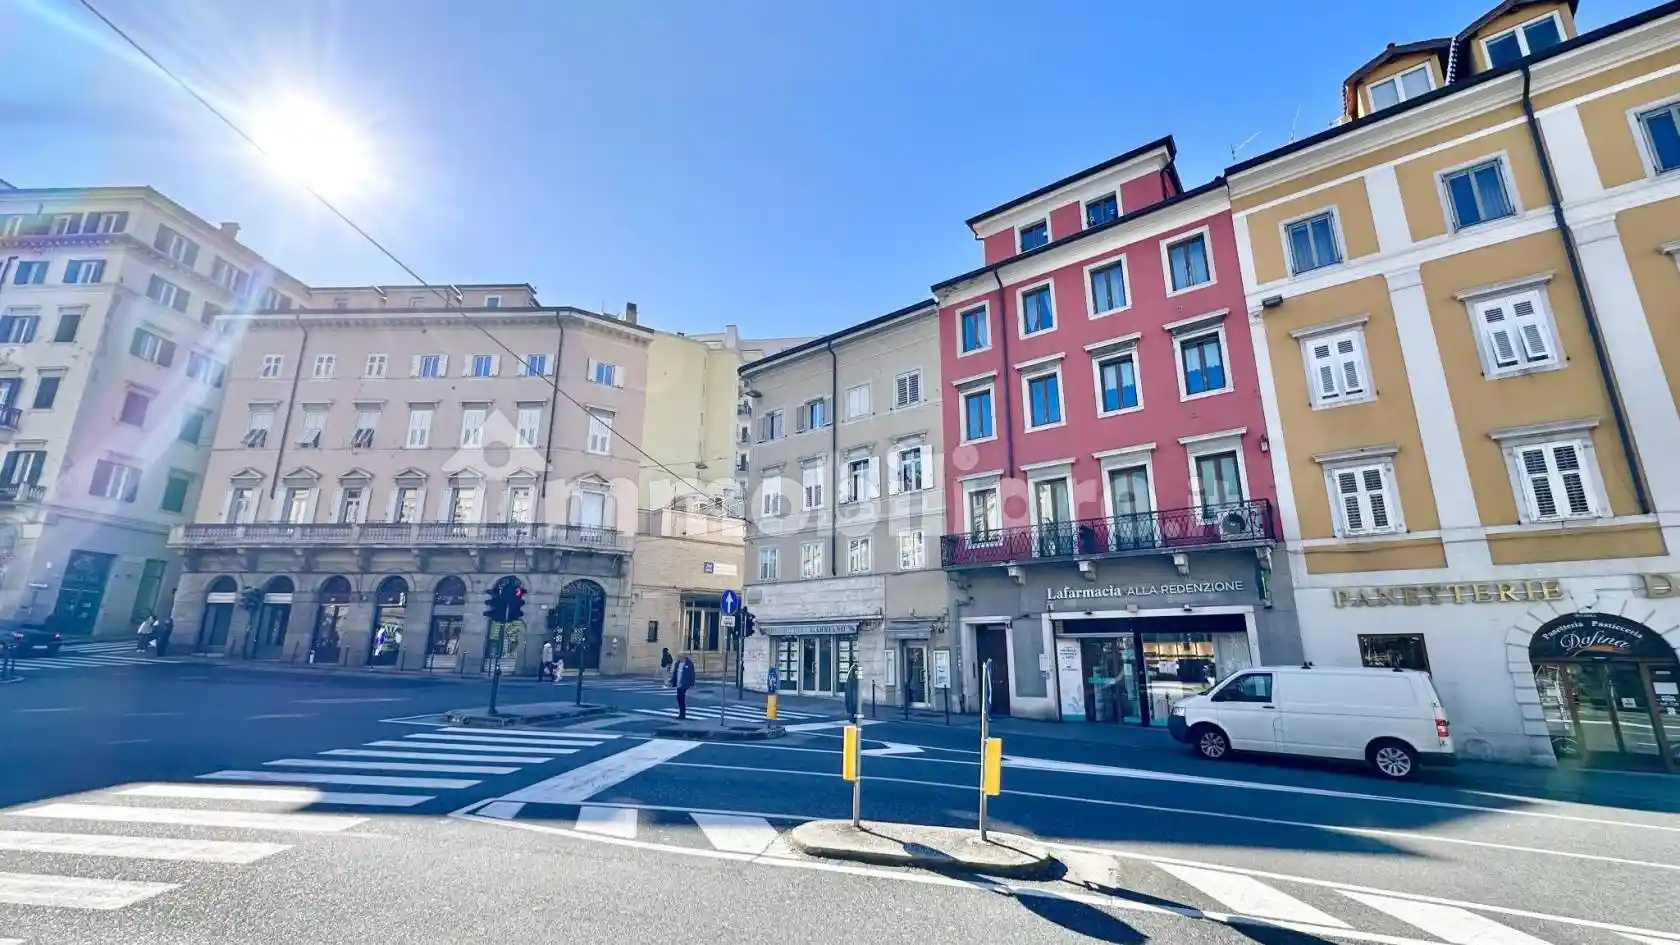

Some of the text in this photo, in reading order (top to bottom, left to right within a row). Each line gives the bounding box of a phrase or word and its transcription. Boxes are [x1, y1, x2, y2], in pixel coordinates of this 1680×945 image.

[1047, 580, 1245, 600] Lafarmacia ALLA REDENZIONE
[1333, 578, 1564, 608] PANETTERIE
[1591, 620, 1644, 639] Pasticceria
